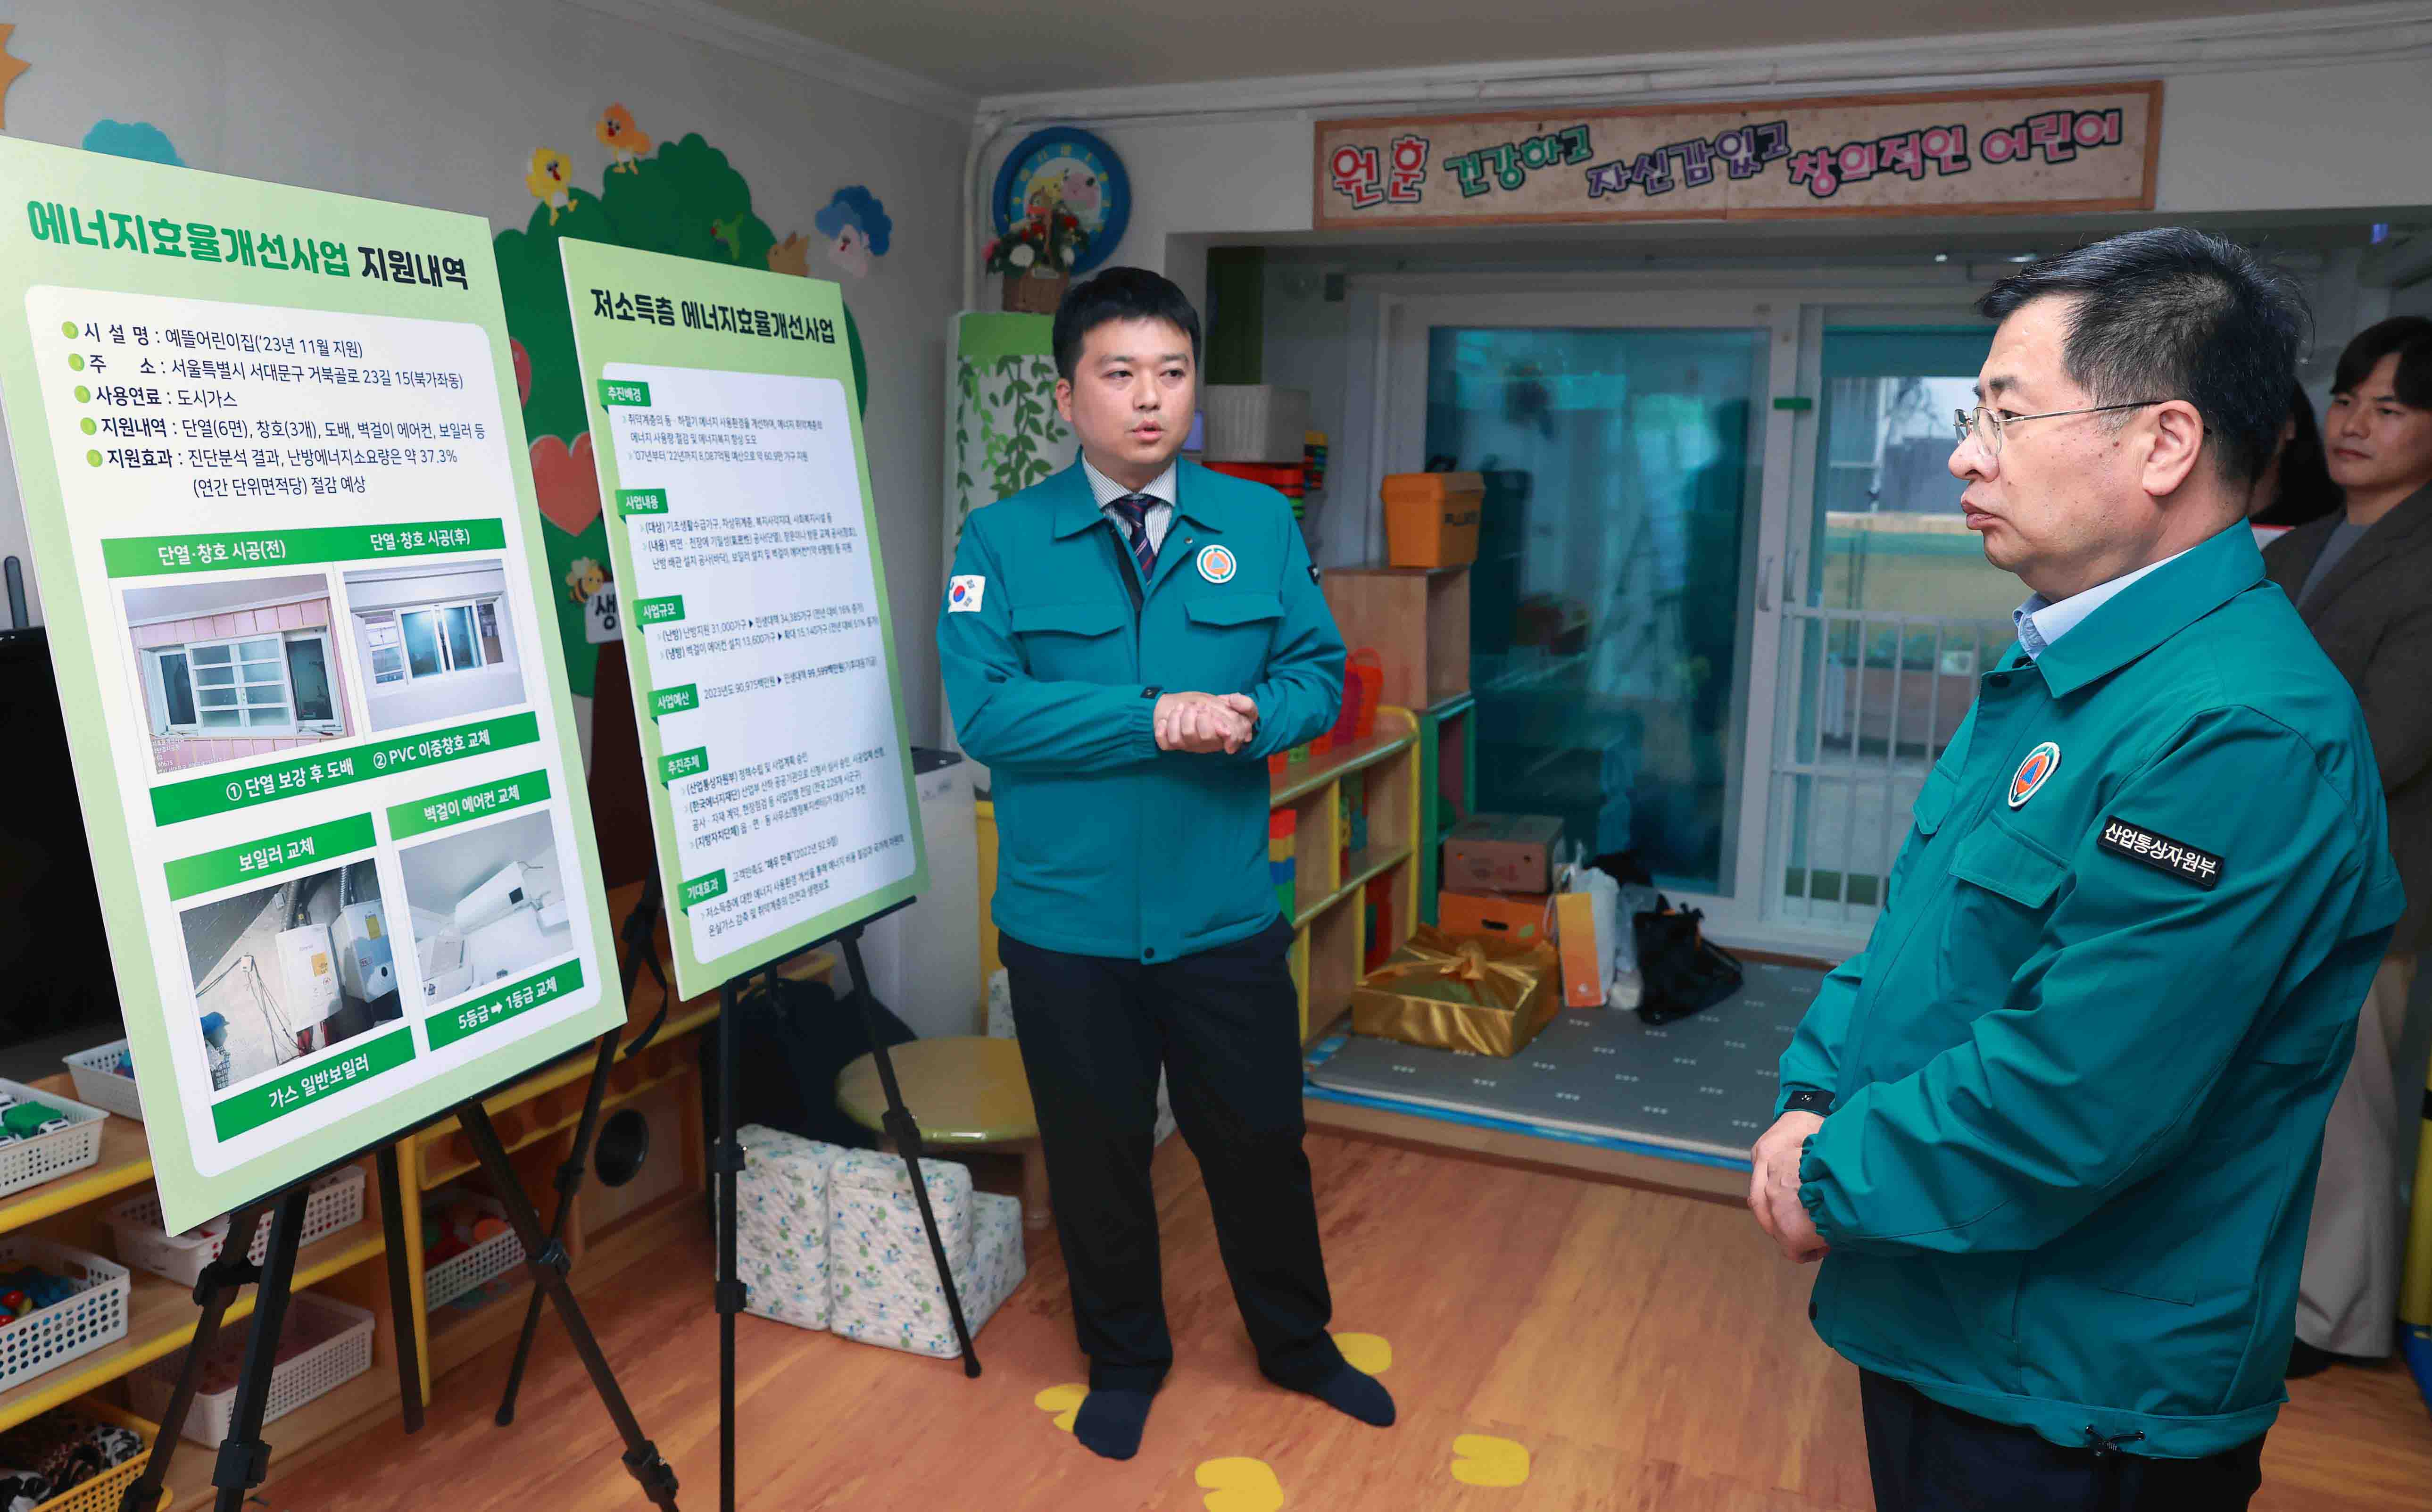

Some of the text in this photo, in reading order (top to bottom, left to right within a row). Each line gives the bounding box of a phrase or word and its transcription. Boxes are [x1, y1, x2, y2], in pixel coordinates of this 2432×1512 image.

[1444, 125, 1593, 197] 건강하고
[1789, 125, 1971, 197] 창의적인
[1981, 108, 2122, 164] 어린이
[25, 200, 469, 291] 에너지효율개선사업 지원내역
[590, 288, 835, 344] 저소득층 에너지효율개선사업
[299, 337, 330, 357] 11월
[332, 339, 363, 359] 지원)
[169, 358, 246, 380] 서울특별시
[249, 362, 306, 383] 서대문구
[307, 366, 360, 385] 거북골로
[362, 368, 392, 386] 23길
[395, 370, 464, 390] 15(북가좌동)
[94, 385, 238, 408] 사용연료 도시가스
[607, 386, 642, 402] 추진배경
[100, 417, 486, 439] 지원내역 단열(6면), 창호(3개), 도배, 벽걸이 에어컨, 보일러 등
[106, 449, 458, 469] 지원효과 진단분석 결과, 난방에너지소요량은 약 37.3%
[191, 475, 367, 498] (연간 단위면적당) 절감 예상
[624, 495, 659, 510] 사업내용
[426, 528, 471, 548] 시공(후)
[645, 522, 665, 533] (대상)
[230, 539, 287, 562] 시공(전)
[648, 540, 668, 552] (내용)
[642, 601, 676, 620] 사업규모
[663, 628, 682, 642] (난방)
[665, 647, 685, 660] (냉방)
[656, 691, 690, 712] 사업예산
[704, 685, 733, 701] 2023년도
[389, 744, 416, 766] PVC
[418, 734, 465, 760] 이중창호
[466, 729, 491, 750] 교체
[667, 754, 700, 776] 추진주체
[244, 773, 275, 798] 단열
[276, 767, 307, 791] 보강
[308, 763, 325, 784] 후
[325, 757, 354, 781] 도배
[686, 771, 738, 796] (산업통상자원부)
[423, 784, 520, 824] 벽걸이 에어컨 교체
[237, 836, 316, 874] 보일러 교체
[2106, 823, 2215, 878] 산업통상자원부
[687, 877, 719, 902] 기대효과
[457, 976, 558, 1031] 5등급 1등급 교체
[267, 1053, 370, 1111] 가스 일반보일러
